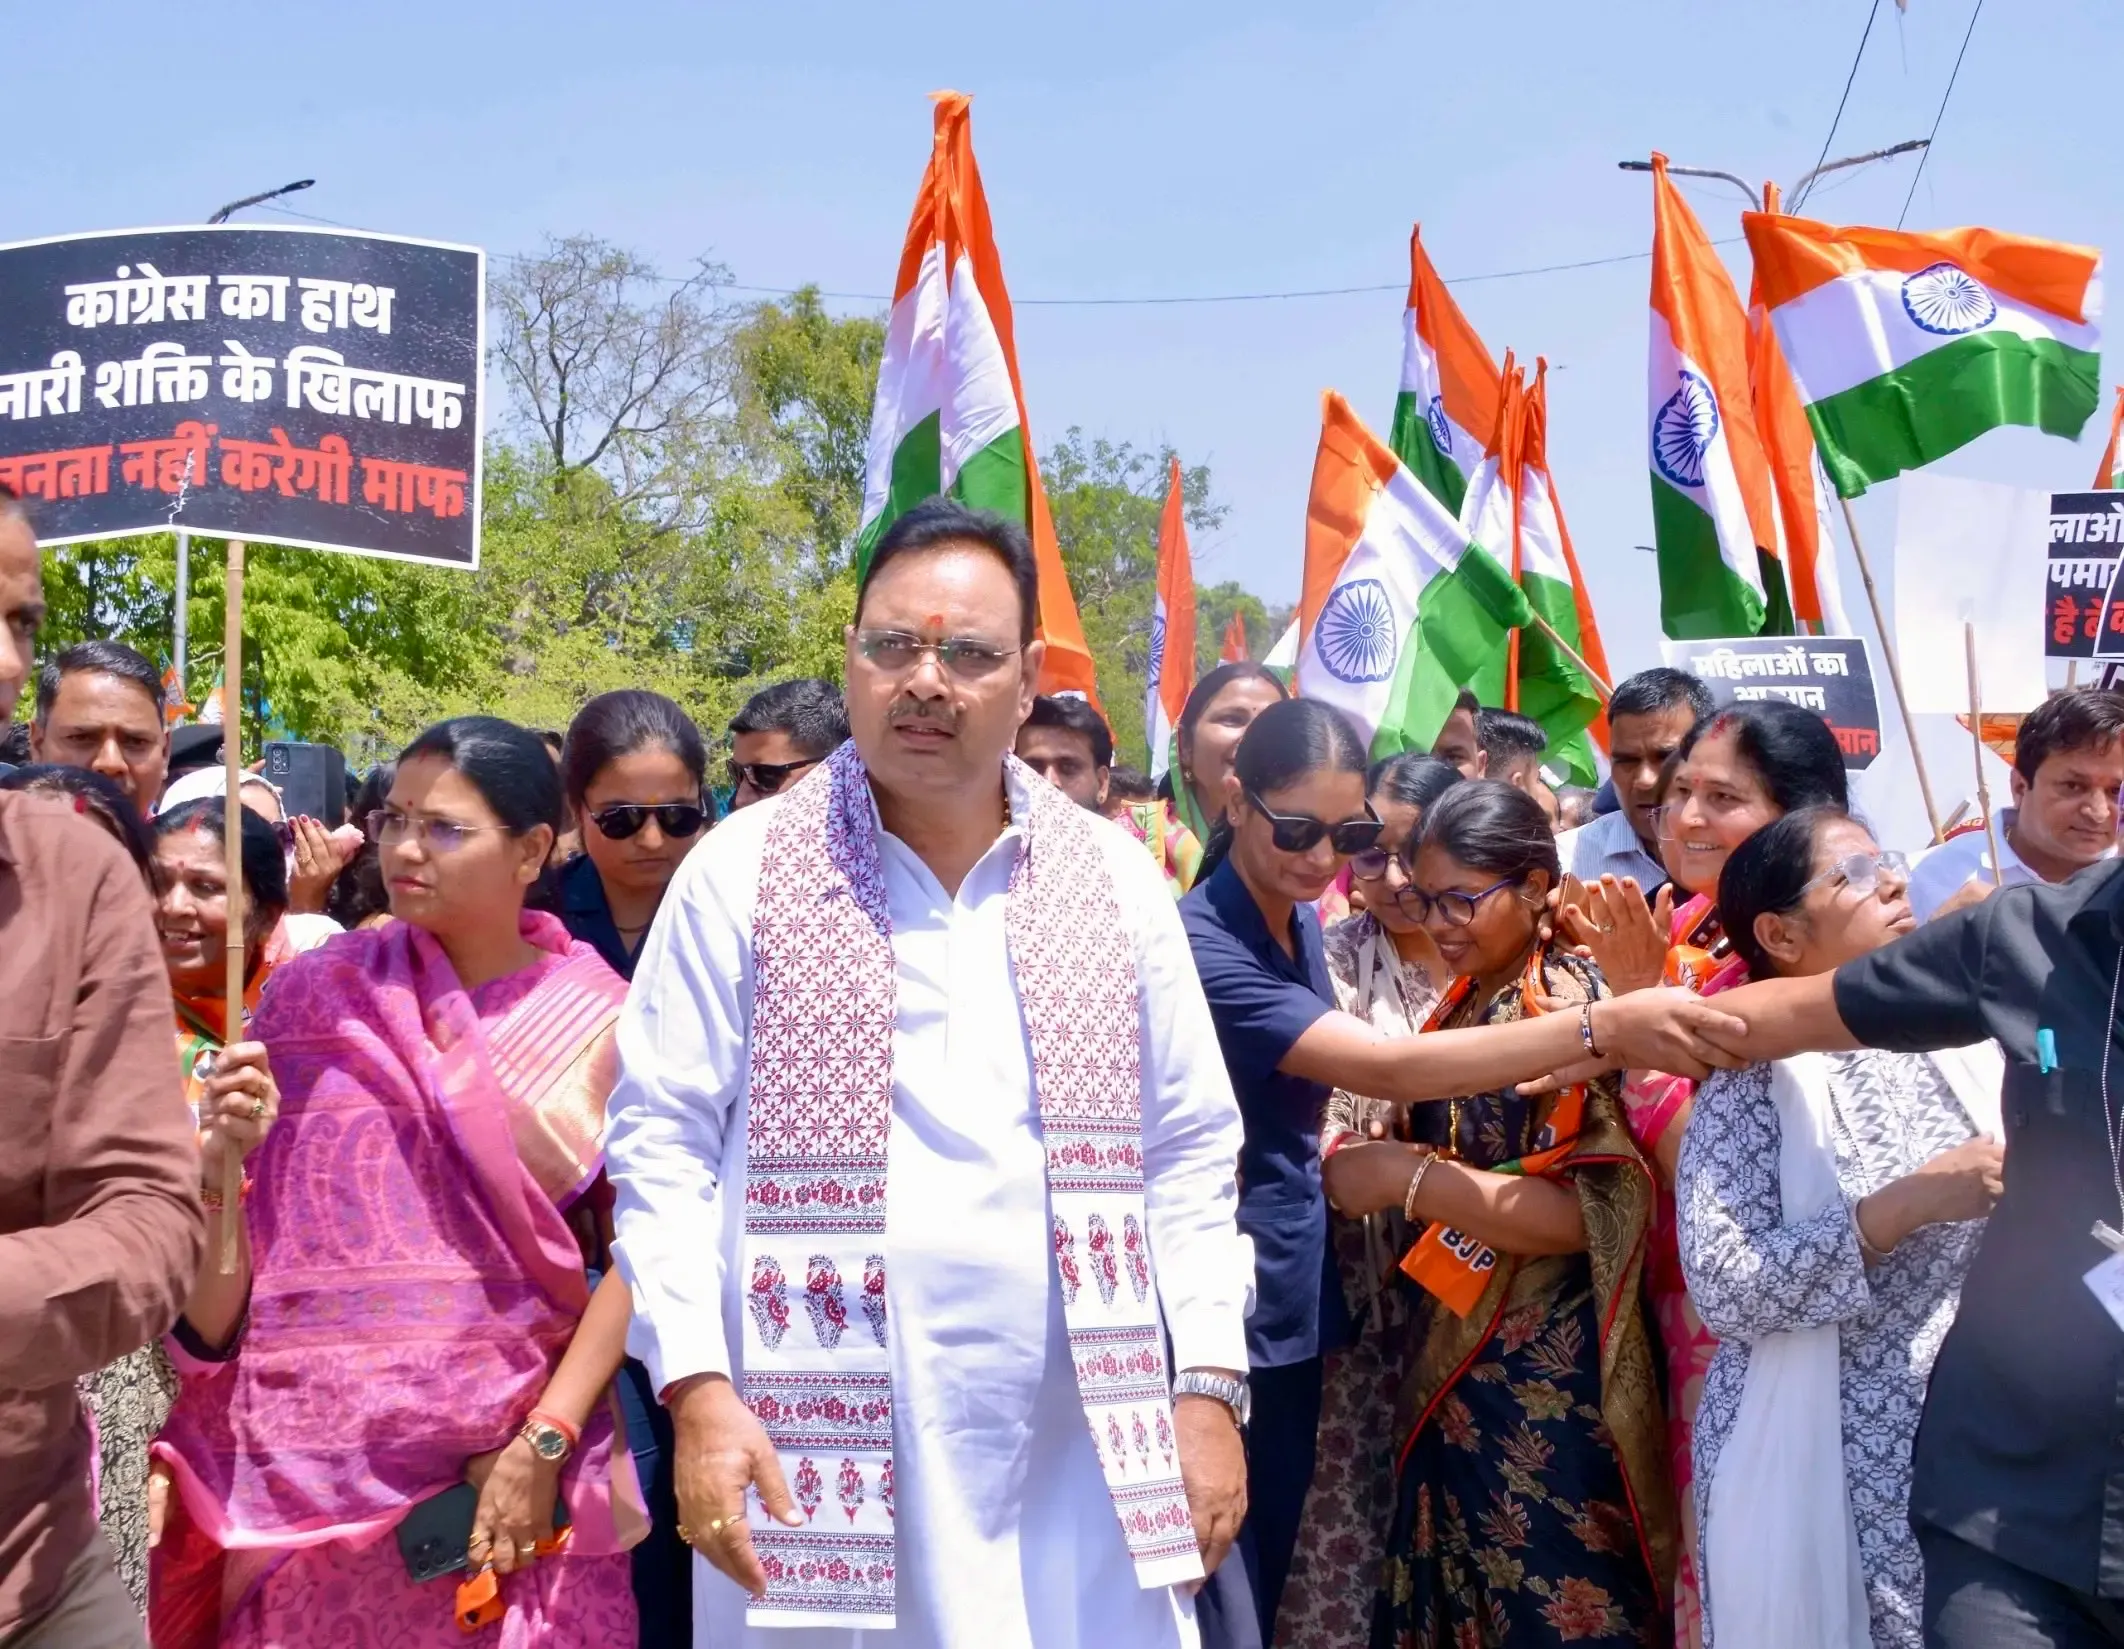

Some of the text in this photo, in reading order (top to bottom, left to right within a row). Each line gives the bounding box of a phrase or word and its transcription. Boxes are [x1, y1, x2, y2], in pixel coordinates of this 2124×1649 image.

[64, 263, 395, 334] कांग्रेस का हाथ
[0, 340, 466, 430] नारी शक्ति के खिलाफ
[120, 420, 218, 494] नहीं
[219, 424, 354, 505] करेगी
[361, 456, 468, 519] माफ
[1690, 646, 1849, 680] महिलाओं का
[1437, 1226, 1497, 1273] BJP
